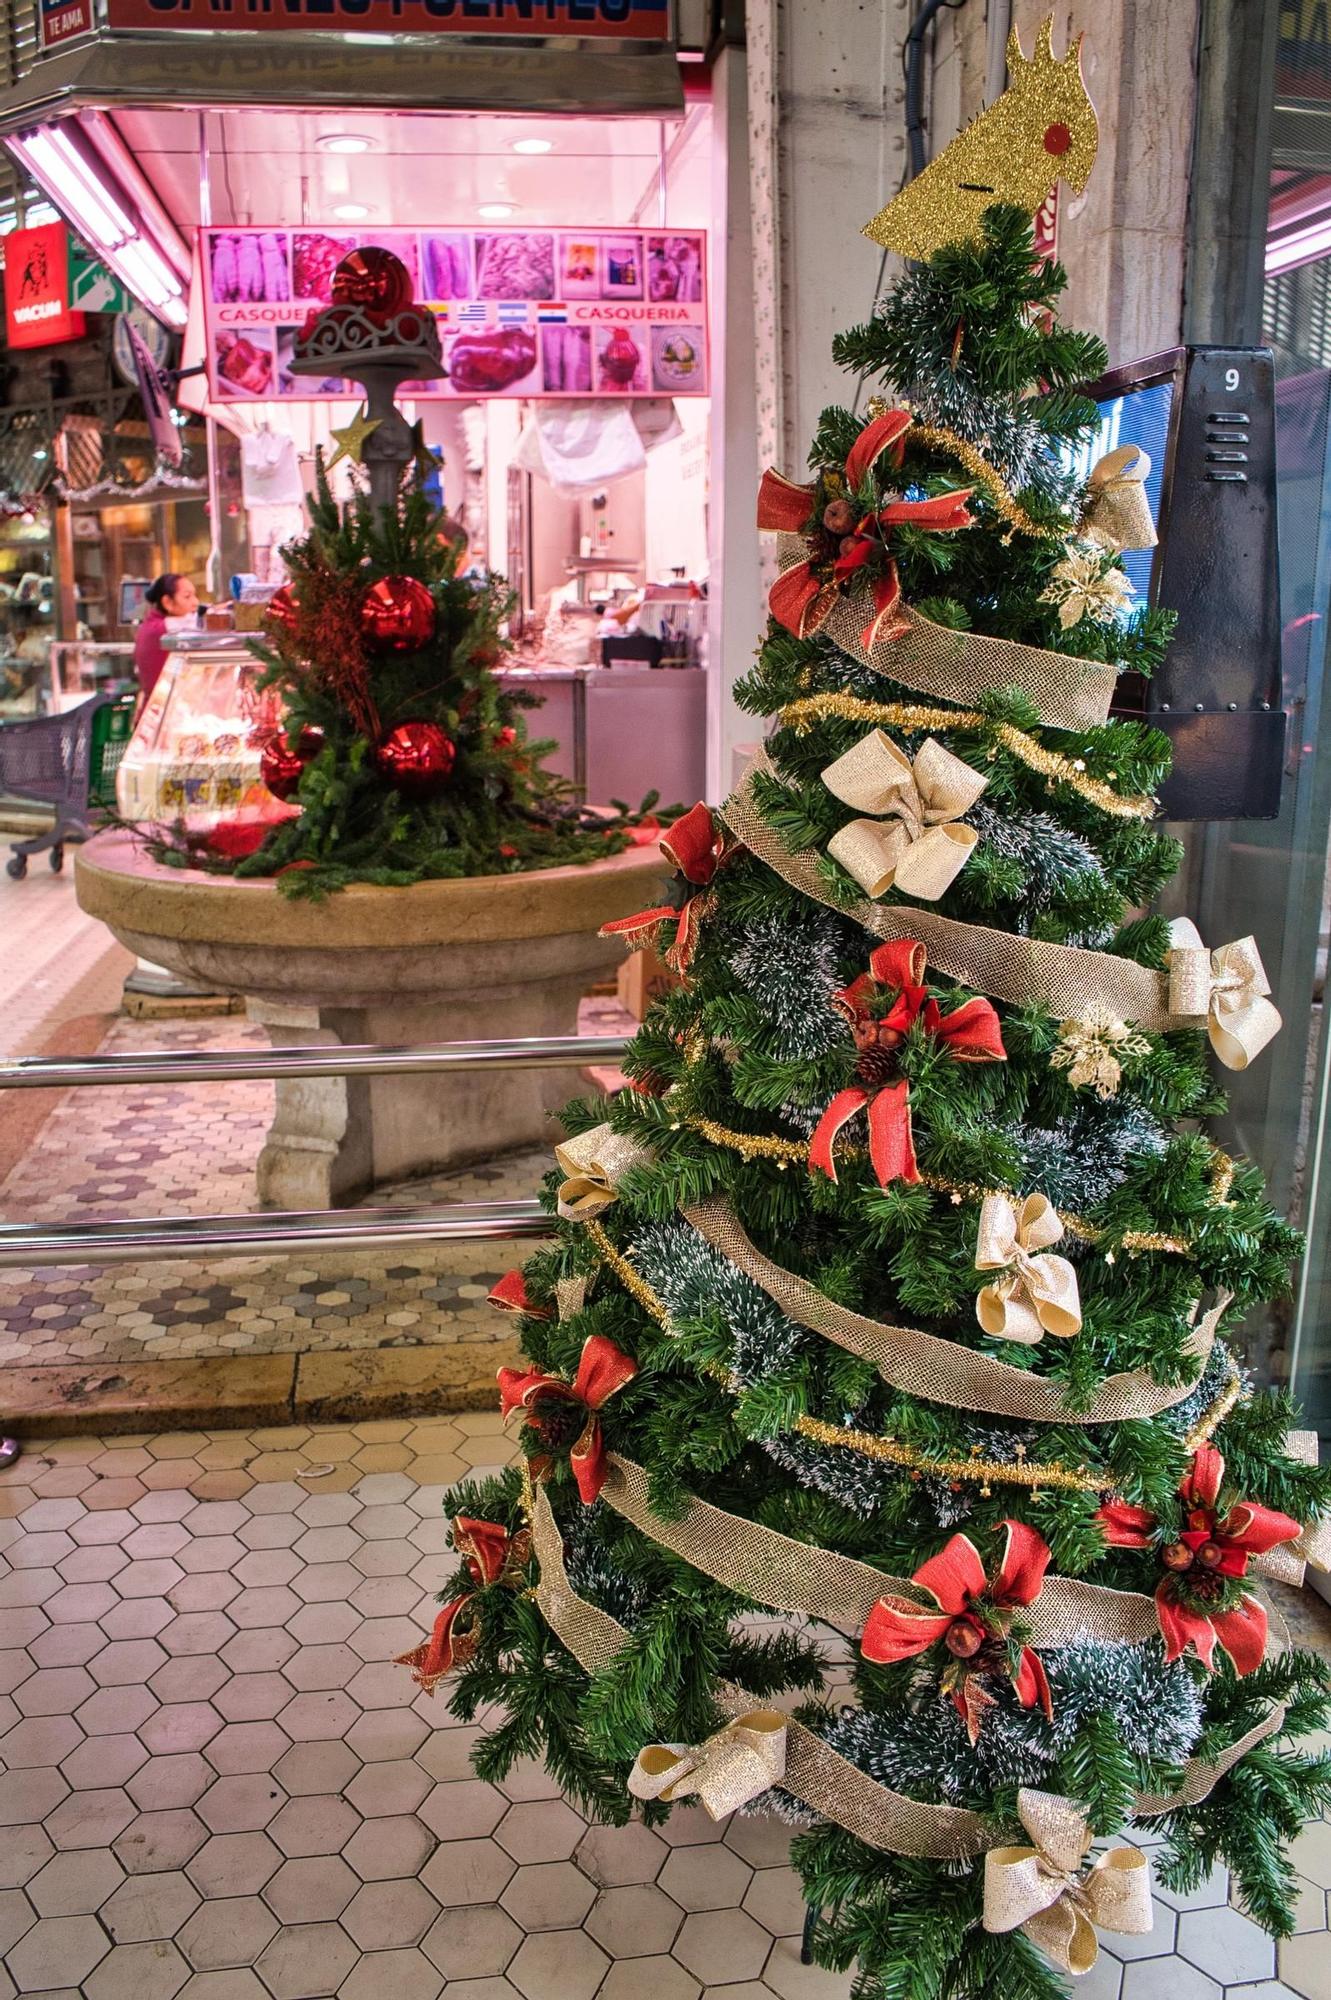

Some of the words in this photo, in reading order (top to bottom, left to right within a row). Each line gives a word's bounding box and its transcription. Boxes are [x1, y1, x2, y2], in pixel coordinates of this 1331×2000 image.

[48, 16, 60, 37] TE
[62, 7, 84, 32] AMA
[219, 307, 304, 321] CASQUE
[575, 307, 689, 320] CASQUERIA
[1225, 368, 1240, 392] 9
